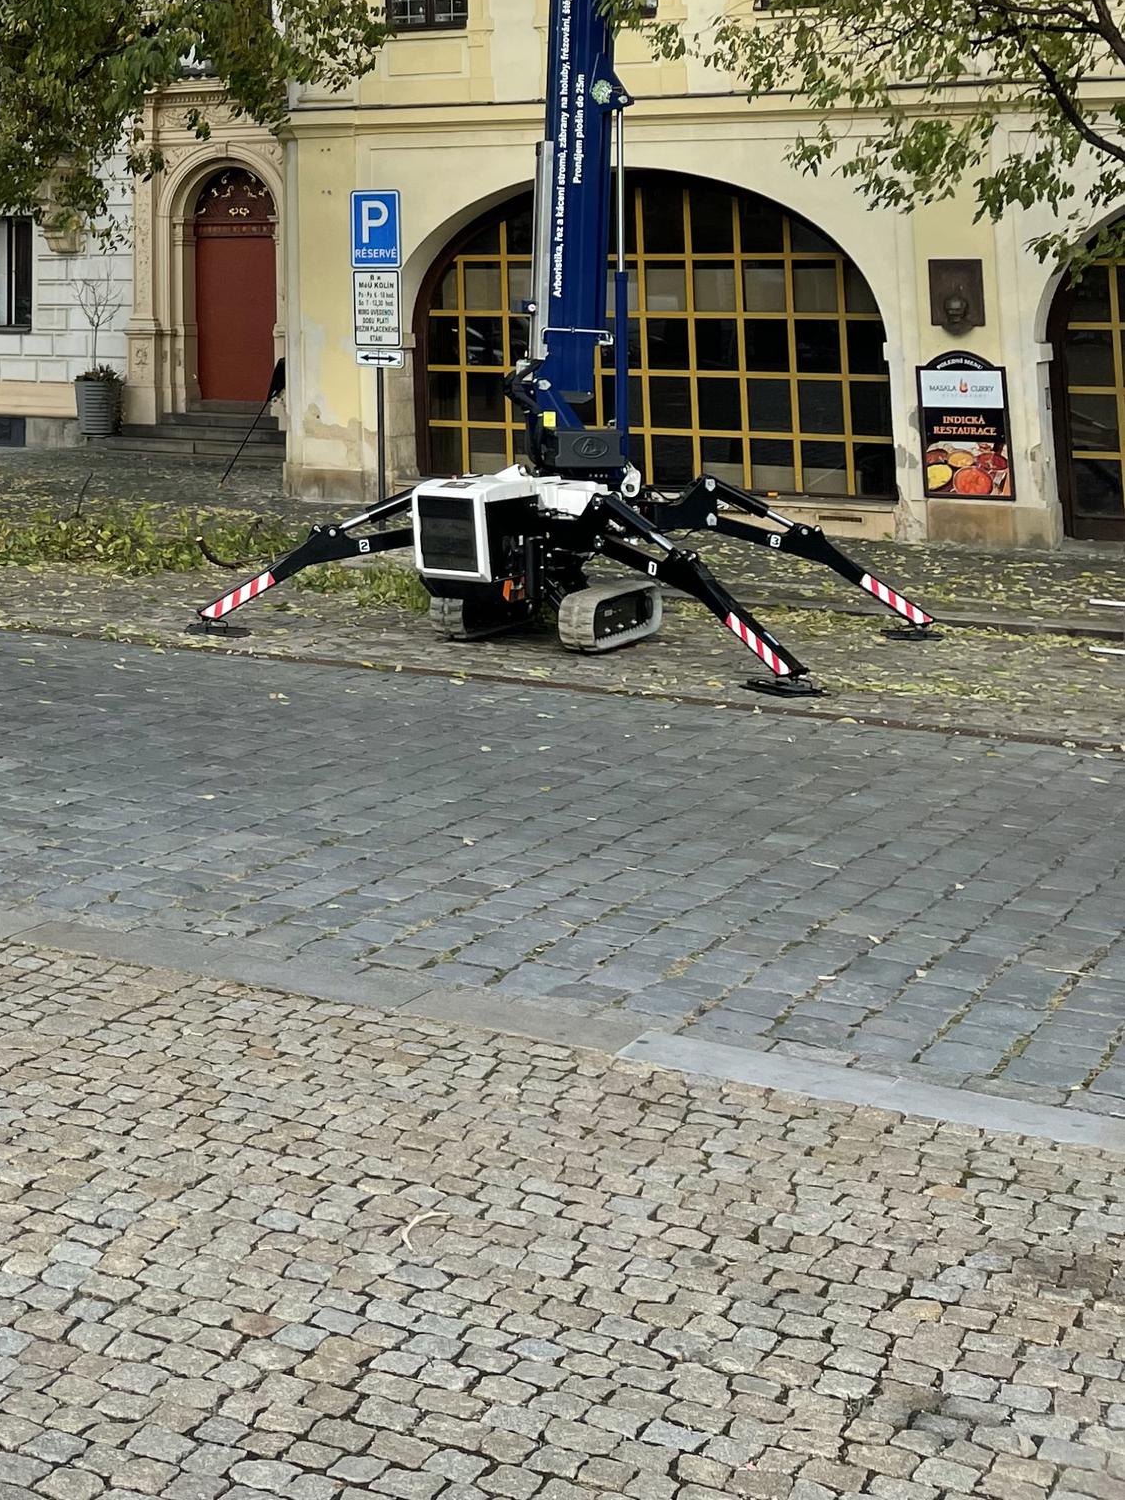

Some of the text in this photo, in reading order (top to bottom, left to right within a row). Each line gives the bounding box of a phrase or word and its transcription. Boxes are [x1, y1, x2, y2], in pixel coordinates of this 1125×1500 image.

[559, 61, 570, 96] holuby,
[560, 96, 568, 109] na
[558, 111, 569, 149] zábrany
[572, 73, 585, 184] Pronájem plošin do 25m
[361, 200, 389, 244] P
[556, 218, 564, 226] a
[355, 246, 397, 259] RÉSERVÉ
[553, 243, 564, 298] Arboristika,
[374, 281, 395, 289] KOLÍN
[942, 414, 986, 425] INDICKÁ
[933, 426, 997, 436] RESTAURACE
[360, 541, 369, 551] 2
[771, 536, 780, 546] 3
